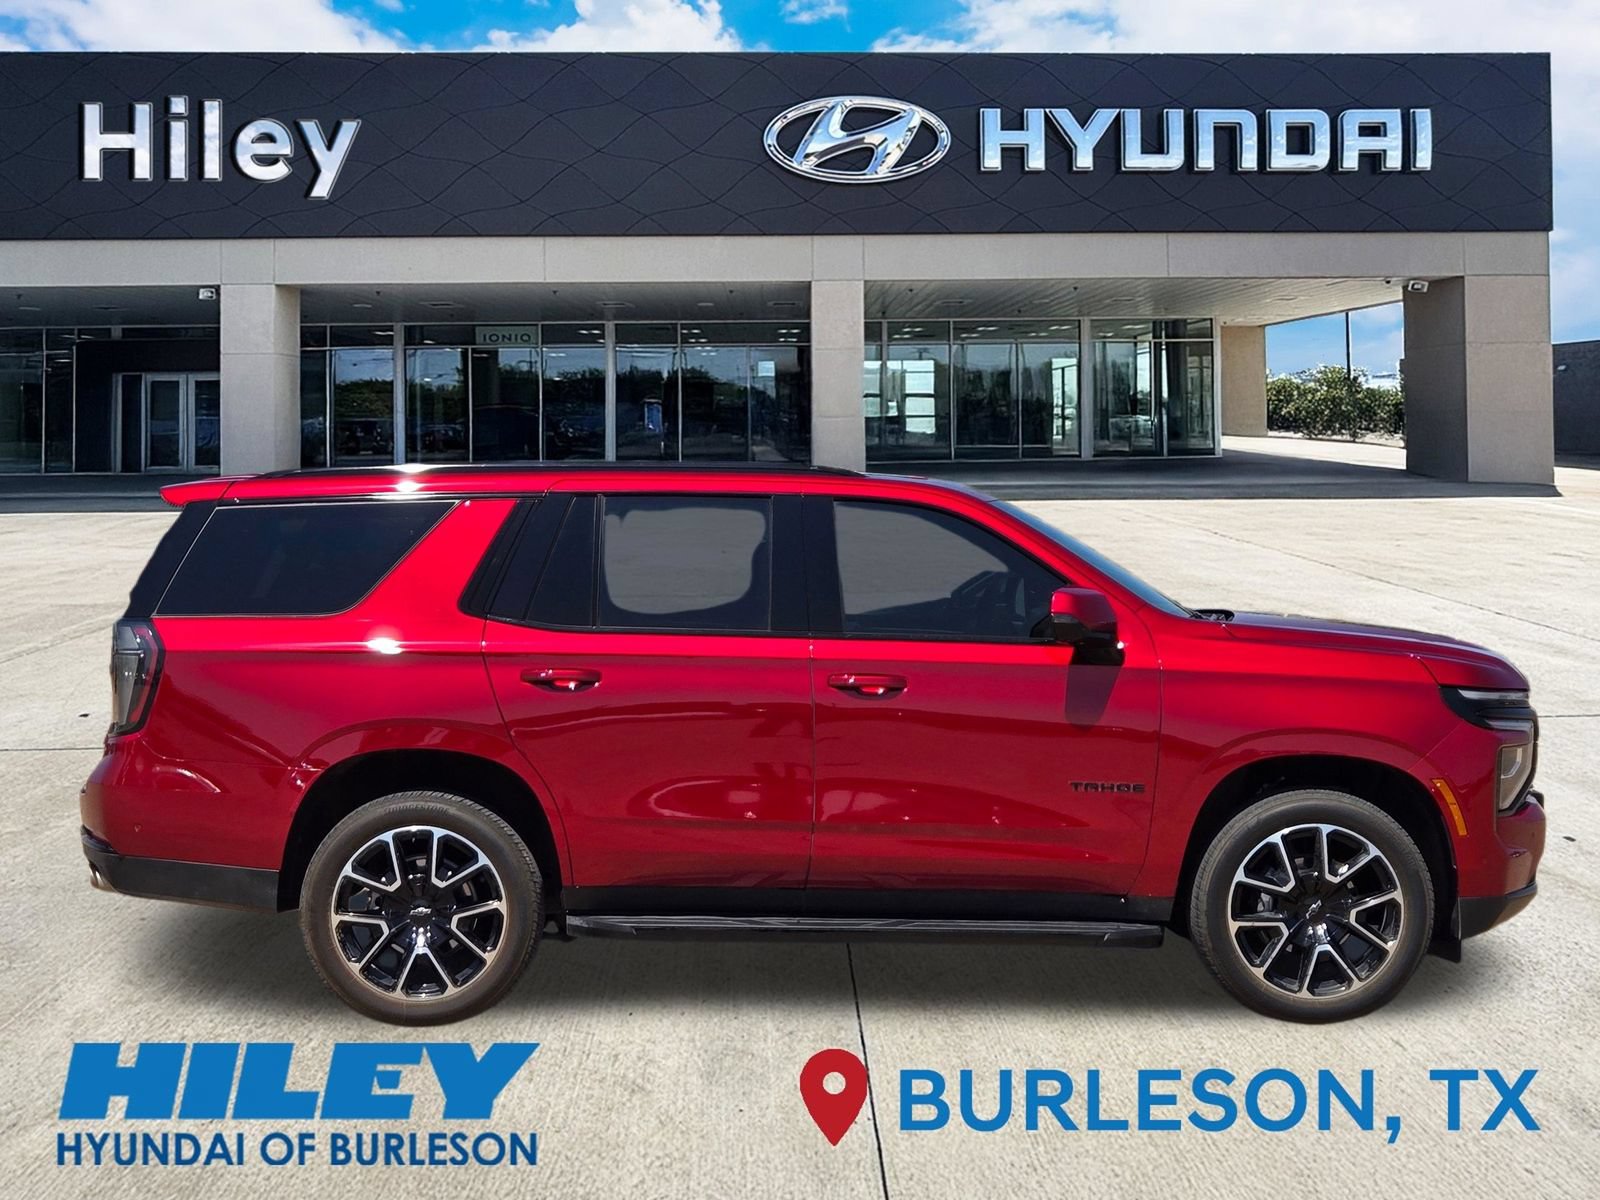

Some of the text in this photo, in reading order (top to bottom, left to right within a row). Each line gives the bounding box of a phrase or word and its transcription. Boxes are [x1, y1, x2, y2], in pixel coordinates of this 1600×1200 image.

[79, 95, 361, 200] Hiley
[979, 106, 1433, 172] HYUNDAI
[482, 332, 532, 343] IONIQ
[1070, 781, 1145, 793] TAHOE
